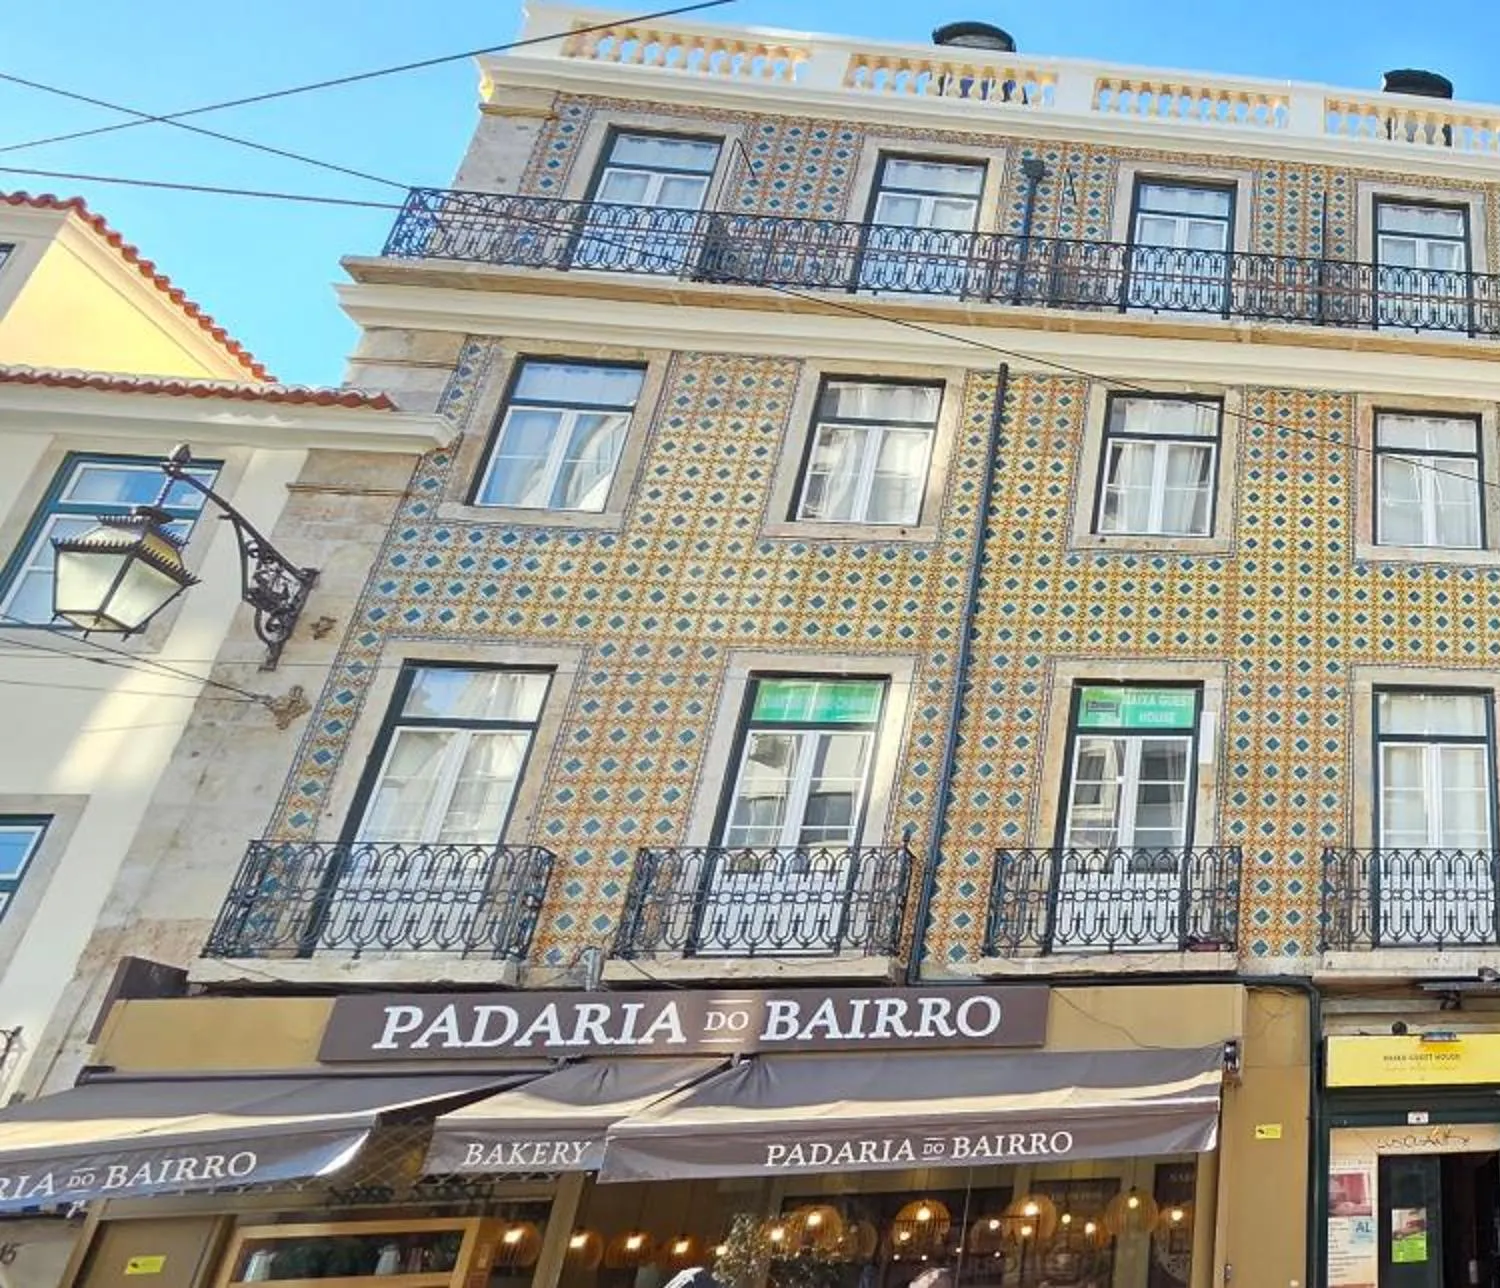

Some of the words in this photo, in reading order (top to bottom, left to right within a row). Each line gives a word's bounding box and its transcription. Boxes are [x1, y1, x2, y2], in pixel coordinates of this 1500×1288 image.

[372, 1001, 687, 1050] PADARIA
[704, 1010, 749, 1032] DO
[759, 995, 1002, 1042] BAIRRO
[463, 1140, 593, 1167] BAKERY
[764, 1138, 917, 1168] PADARIA
[922, 1143, 946, 1155] DO
[950, 1131, 1074, 1160] BAIRRO
[67, 1173, 96, 1188] DO
[101, 1151, 257, 1190] BAIRRO
[1355, 1221, 1372, 1233] AL
